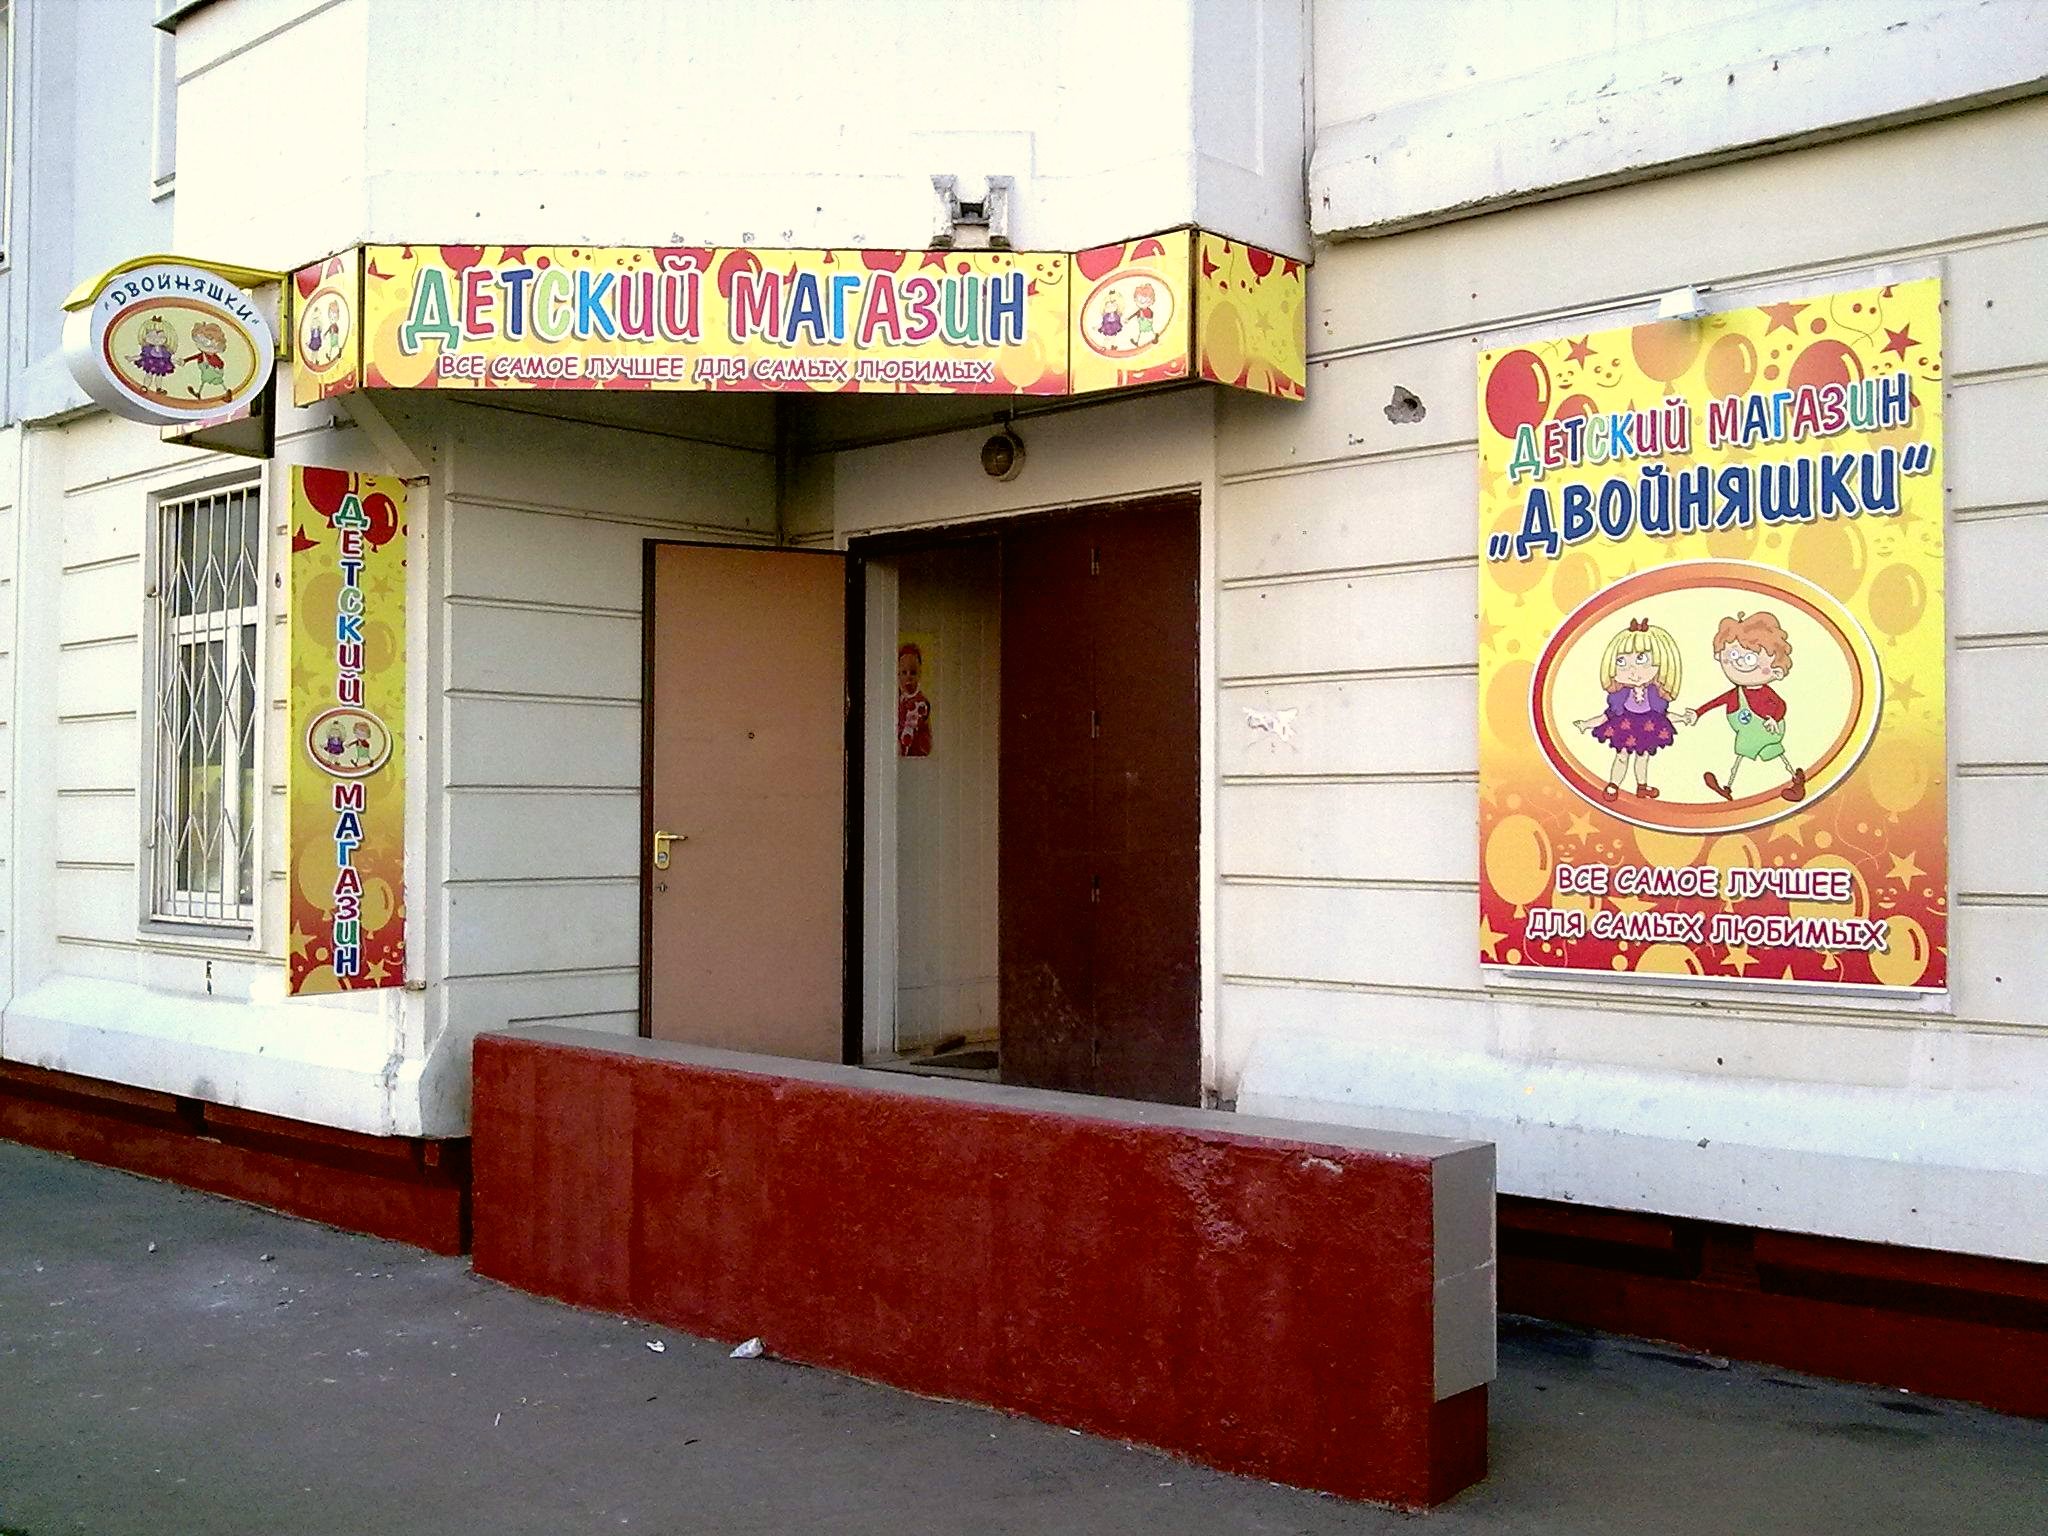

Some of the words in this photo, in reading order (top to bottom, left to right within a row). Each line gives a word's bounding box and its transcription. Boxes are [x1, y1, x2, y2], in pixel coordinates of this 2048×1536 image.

[405, 256, 700, 350] ДЕТСКИЙ
[734, 271, 1024, 344] МАГАЗИН
[439, 354, 485, 376] ВСЕ
[493, 355, 578, 378] САМОЕ
[587, 356, 684, 379] ЛУЧШЕЕ
[699, 357, 746, 379] ДЛЯ
[756, 358, 848, 380] САМЫХ
[856, 359, 993, 381] ЛЮБИМЫХ
[1509, 399, 1688, 479] ДЕТСКИЙ
[1707, 372, 1912, 446] МАГАЗИН
[335, 496, 368, 703] ДЕТСКИЙ
[334, 783, 363, 975] МАГАЗИН
[1558, 866, 1606, 892] ВСЕ
[1617, 867, 1717, 894] САМОЕ
[1728, 869, 1850, 898] ЛУЧШЕЕ
[1528, 912, 1583, 938] ДЛЯ
[1593, 914, 1703, 942] САМЫХ
[1710, 916, 1888, 948] ЛЮБИМЫХ
